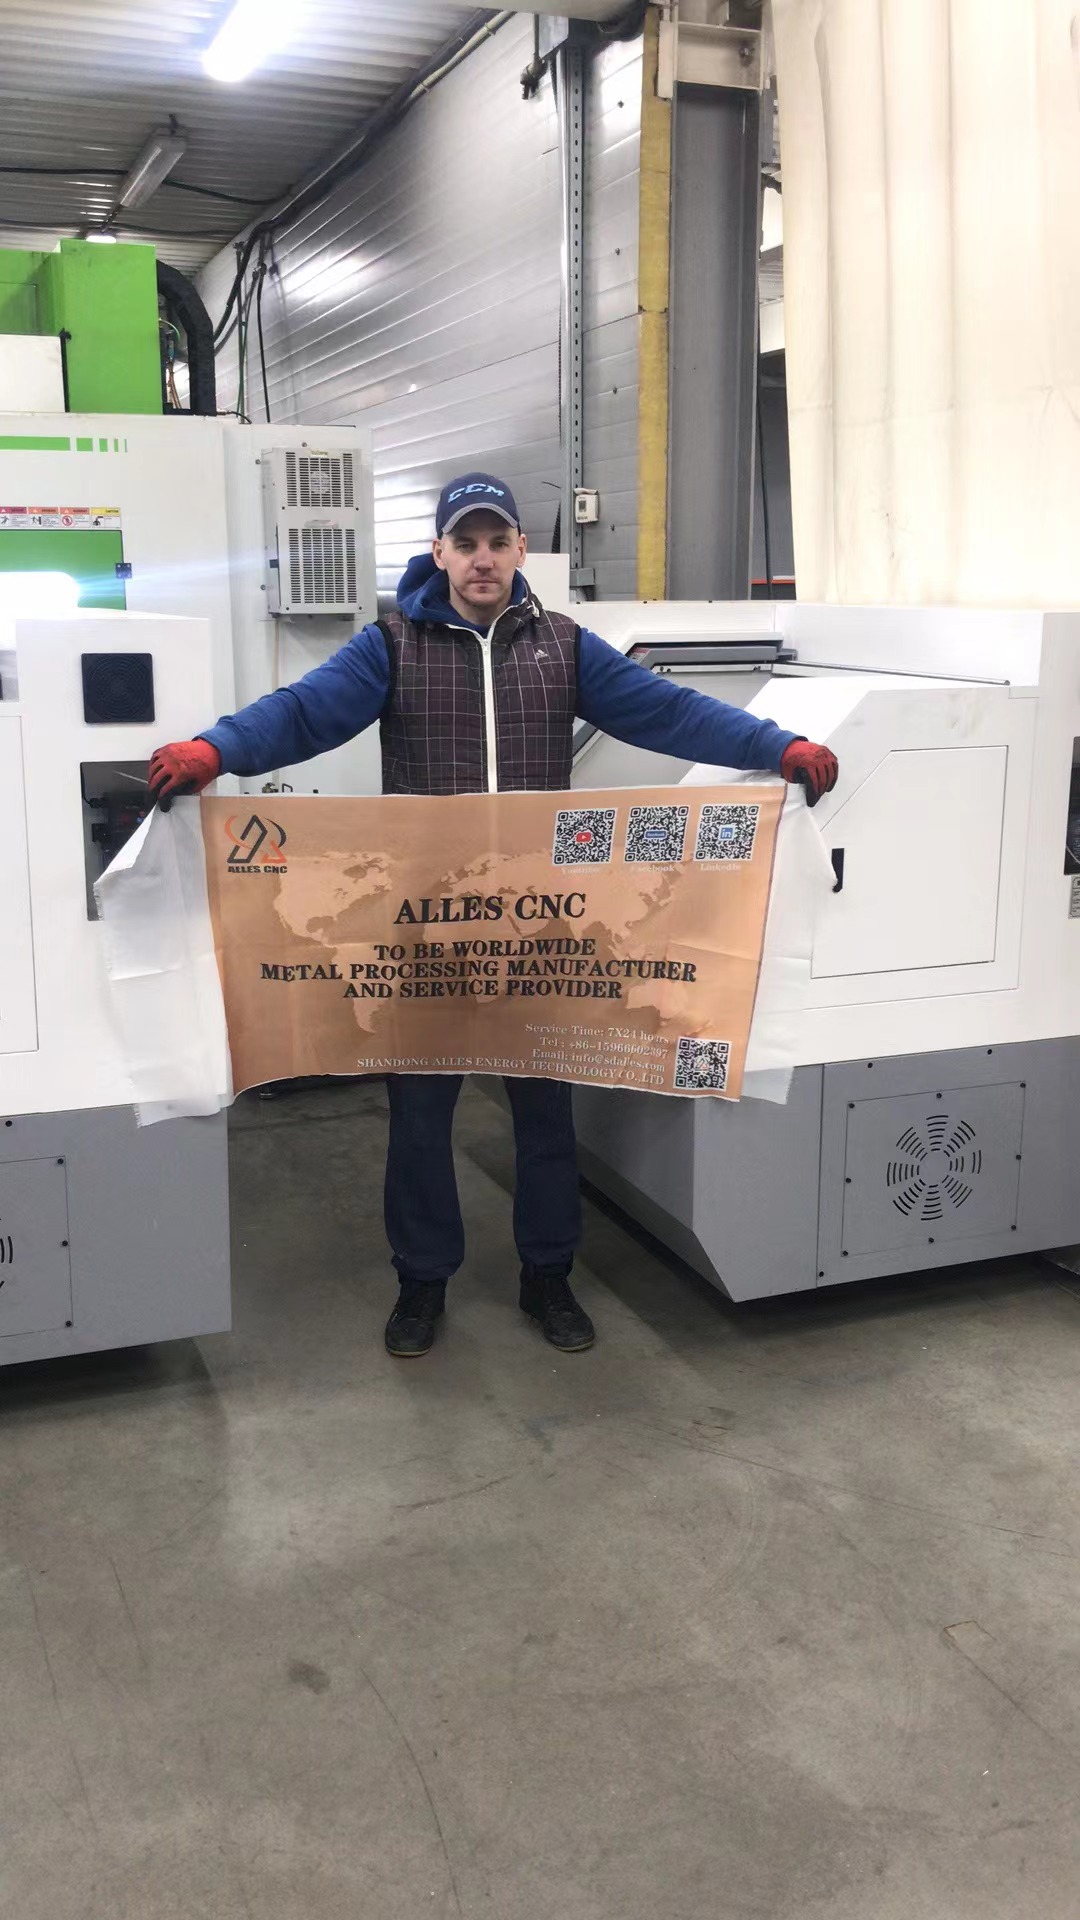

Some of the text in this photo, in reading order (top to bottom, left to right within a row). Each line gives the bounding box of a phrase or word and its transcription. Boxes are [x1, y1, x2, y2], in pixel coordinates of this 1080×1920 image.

[448, 483, 505, 503] CCM
[228, 865, 288, 873] ALLES CNC
[393, 892, 587, 925] ALLES CNC
[373, 938, 596, 961] TO BE WORLDWIDE
[260, 958, 697, 983] METAL PROCESSING MANUFACTURER
[343, 979, 623, 999] AND SERVICE PROVIDER
[525, 1023, 568, 1033] Service
[571, 1025, 604, 1037] Time:
[608, 1027, 637, 1039] 7X24
[531, 1048, 568, 1061] Email:
[357, 1057, 429, 1068] SHANDONG
[433, 1057, 473, 1067] ALLES
[475, 1057, 528, 1069] ENERGY
[531, 1060, 617, 1078] TECHNOLOGY
